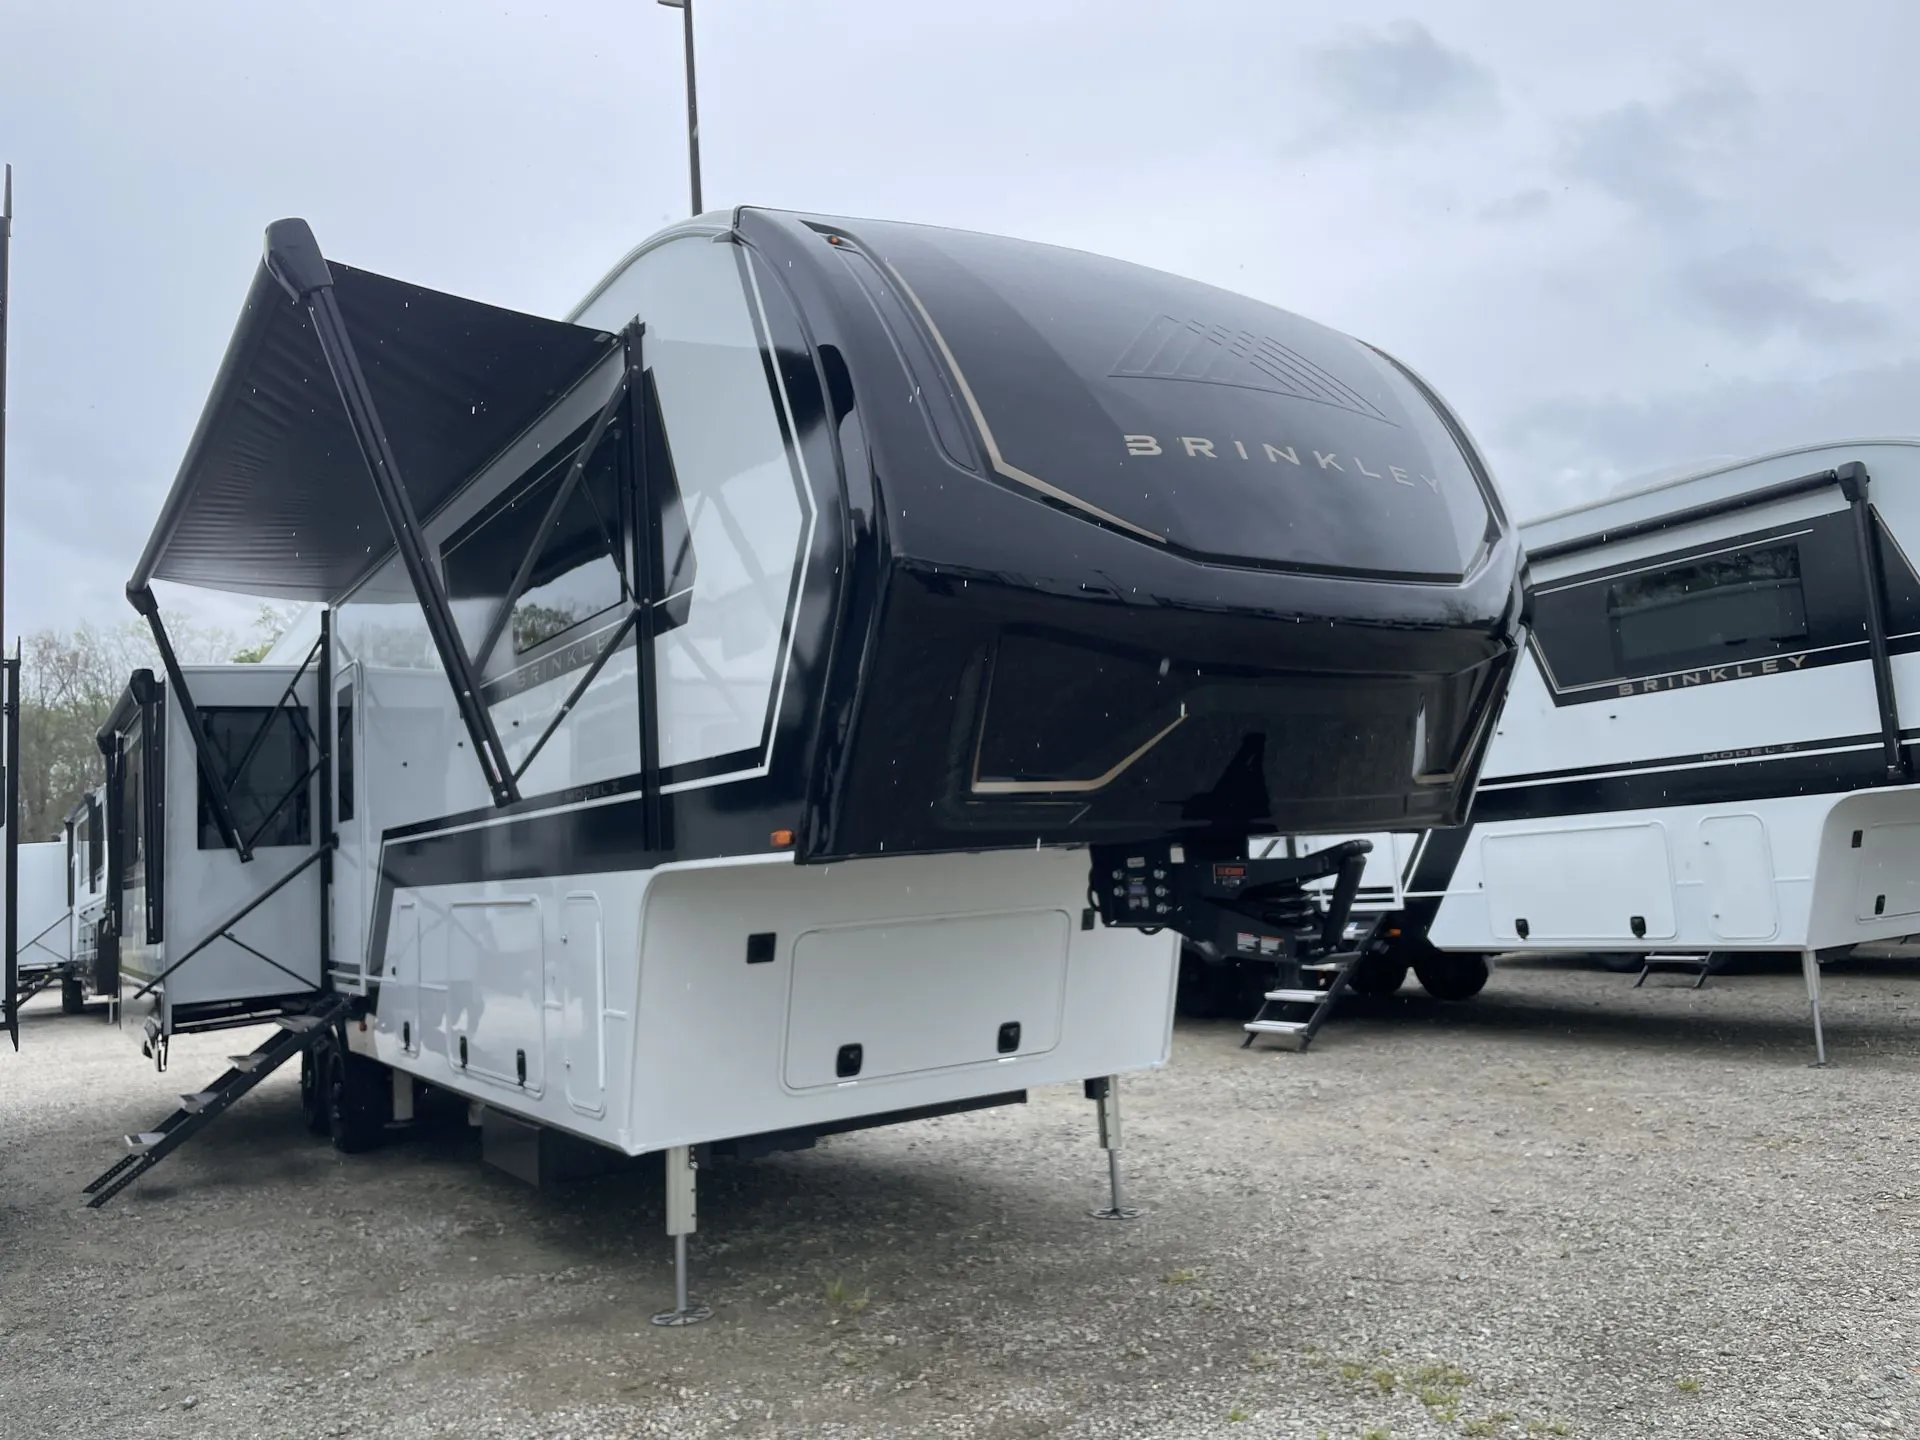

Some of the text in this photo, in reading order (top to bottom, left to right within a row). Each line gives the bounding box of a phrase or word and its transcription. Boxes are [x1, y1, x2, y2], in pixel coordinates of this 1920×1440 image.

[1123, 434, 1439, 494] BRINKLEY
[518, 632, 612, 687] BRINKLE
[1617, 654, 1808, 696] BRINKLEY
[1702, 747, 1775, 761] MODEL
